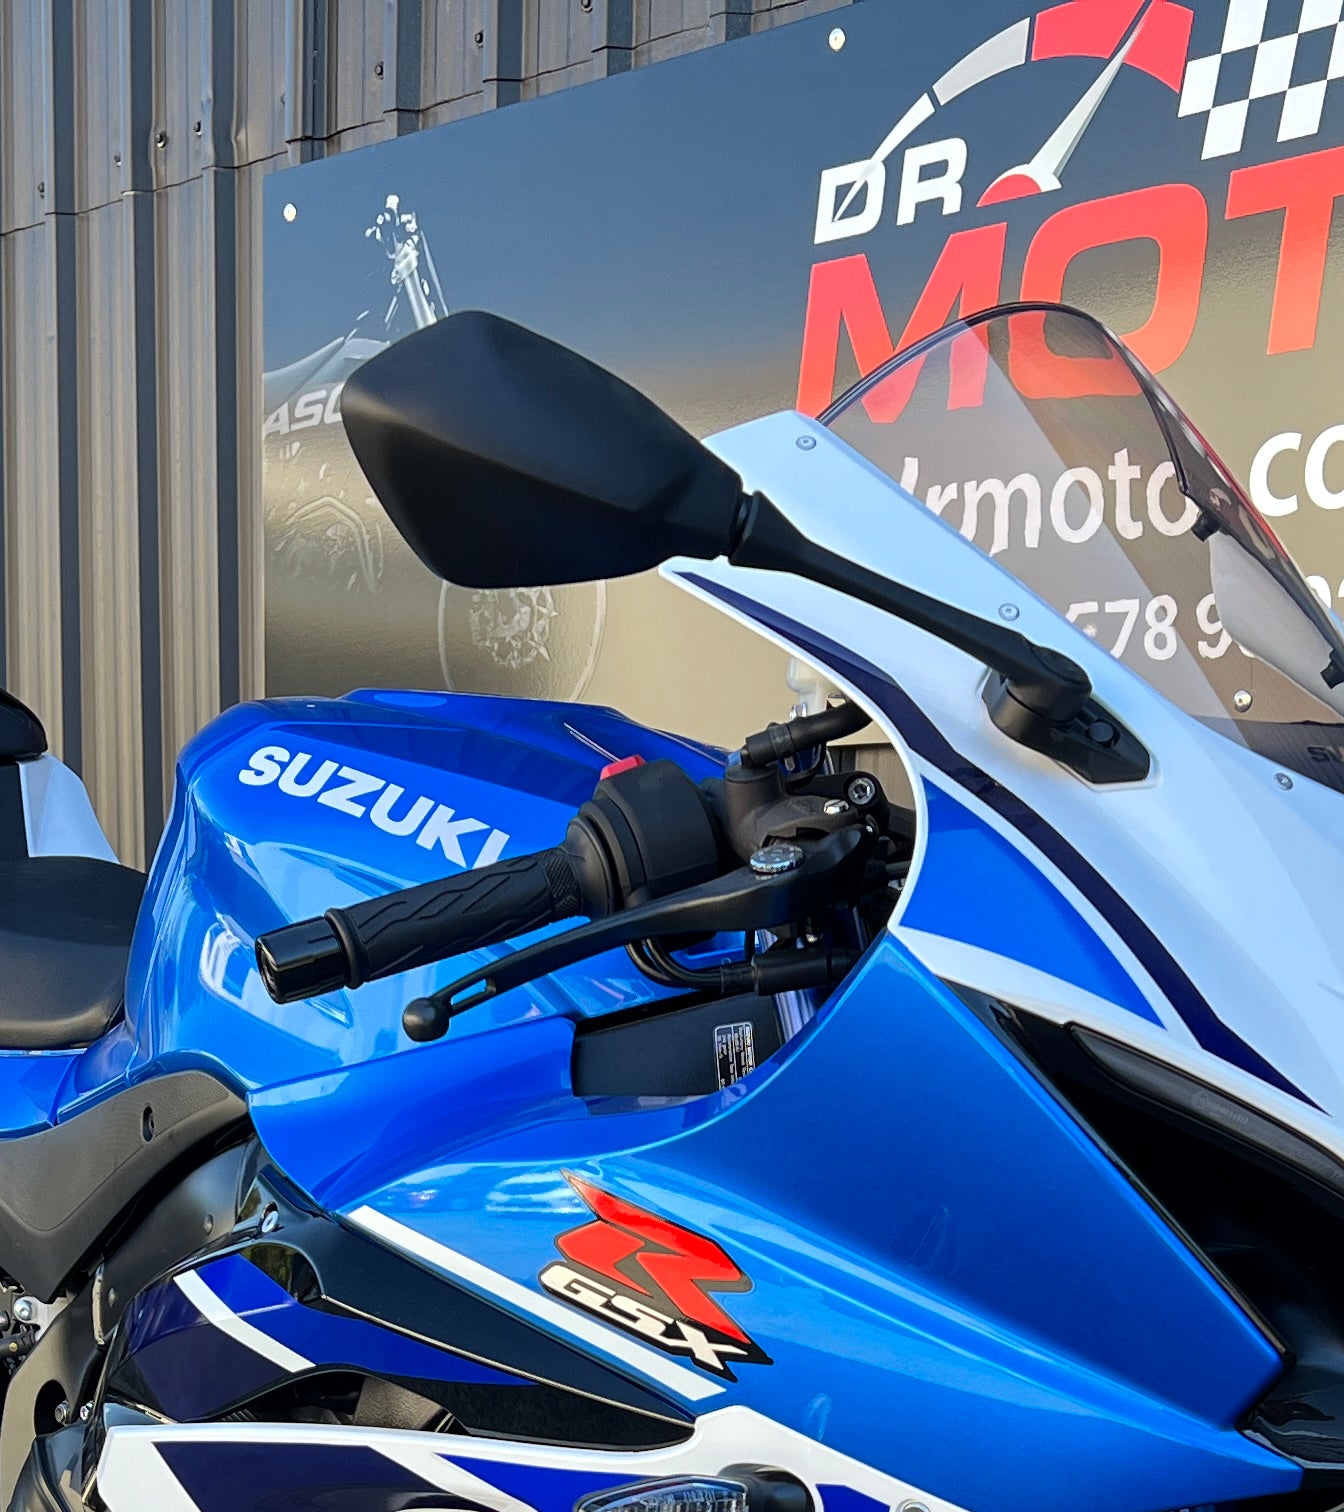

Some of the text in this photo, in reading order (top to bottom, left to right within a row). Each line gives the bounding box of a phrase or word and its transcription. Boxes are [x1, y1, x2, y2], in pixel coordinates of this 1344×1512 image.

[813, 137, 968, 245] DR
[238, 745, 512, 870] SUZUKI
[539, 1264, 749, 1371] GSX
